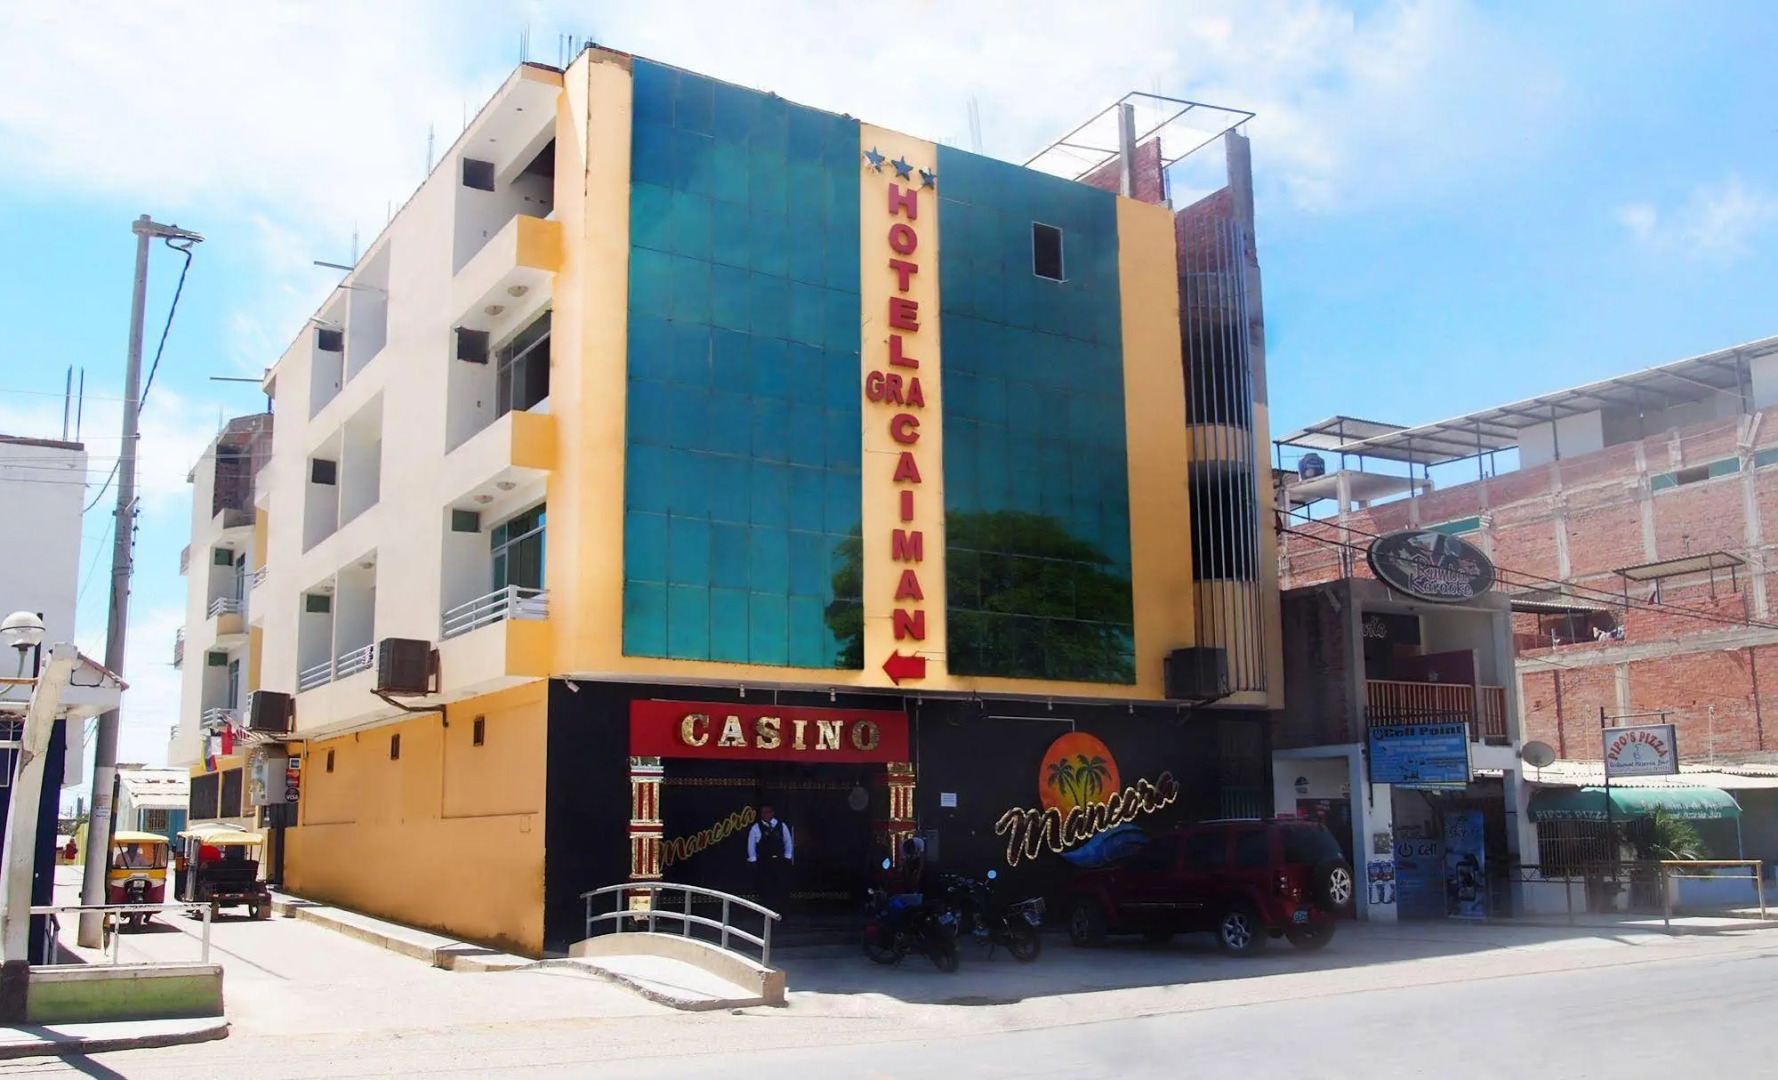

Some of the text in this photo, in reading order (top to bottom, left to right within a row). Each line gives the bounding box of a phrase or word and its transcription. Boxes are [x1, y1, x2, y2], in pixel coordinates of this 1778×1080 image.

[888, 182, 919, 369] HOTEL
[866, 370, 925, 408] GRA
[890, 413, 926, 641] CAIMAN
[681, 713, 880, 751] CASINO
[1384, 725, 1463, 737] Cell Point
[1607, 731, 1669, 761] PIPO'S PIZZA
[995, 771, 1179, 867] Mancora
